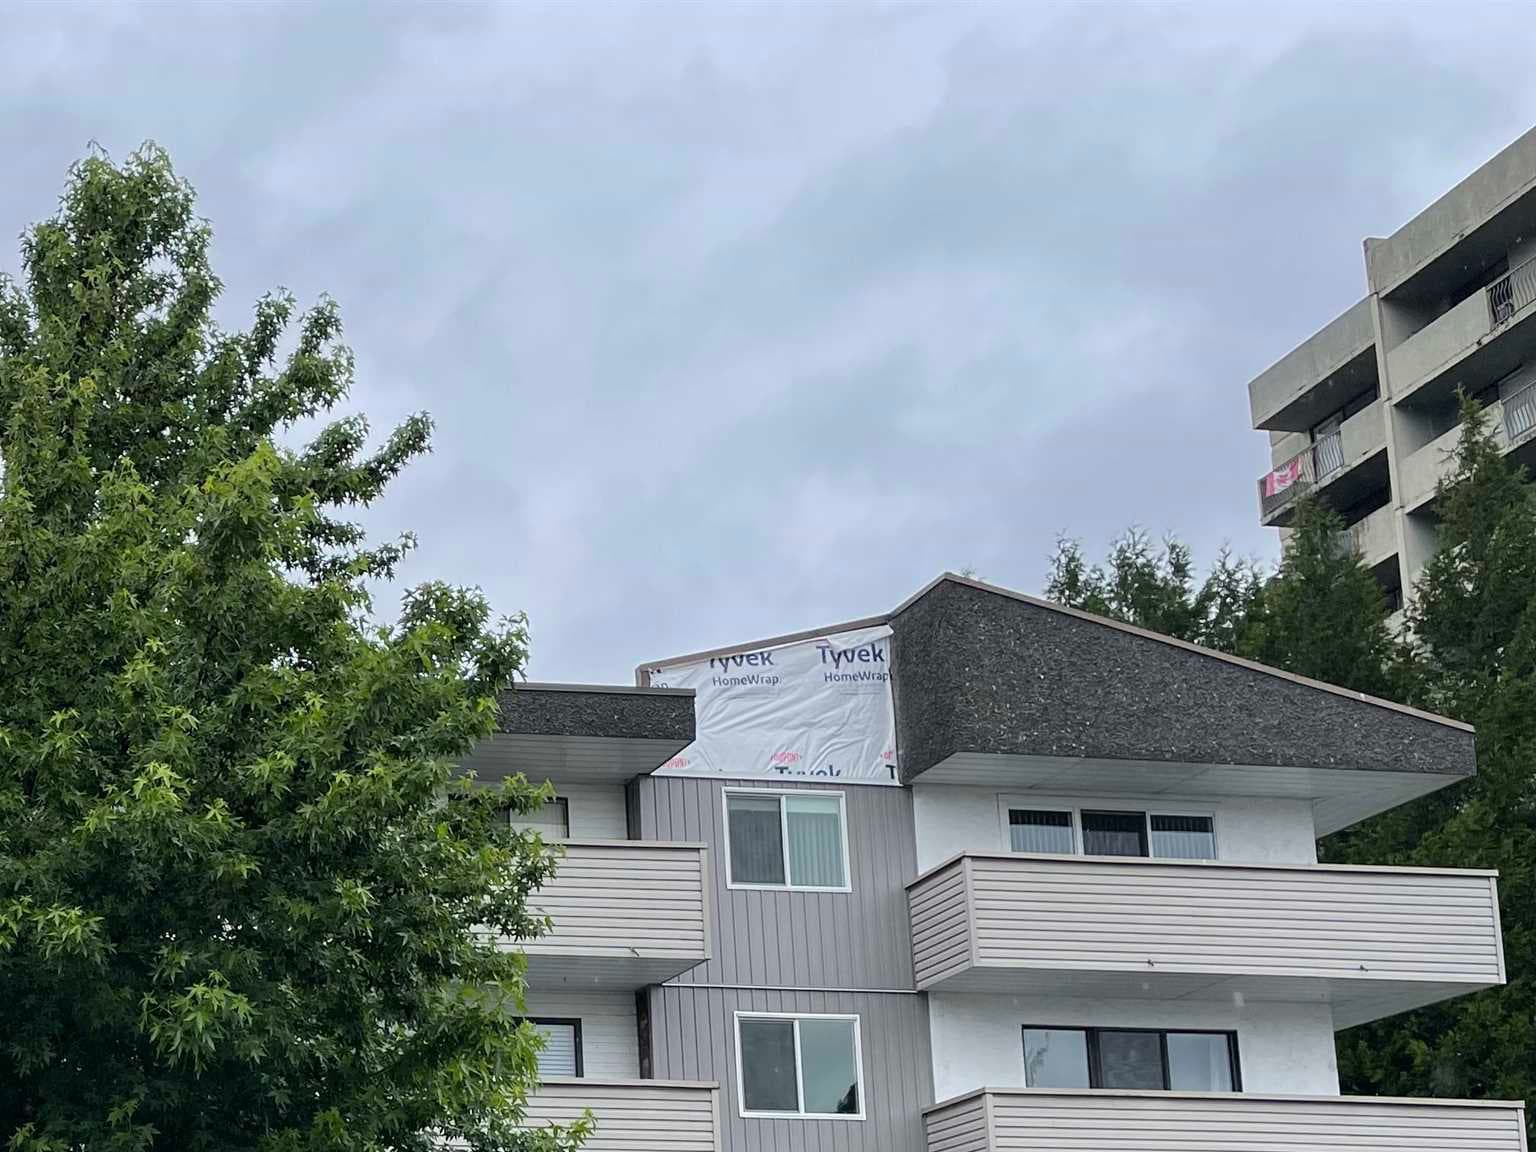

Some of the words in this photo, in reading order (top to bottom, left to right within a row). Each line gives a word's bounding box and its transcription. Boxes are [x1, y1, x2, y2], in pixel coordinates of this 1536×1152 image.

[816, 643, 885, 670] Tyvek
[712, 674, 779, 687] HomeWrap
[824, 671, 890, 683] HomeWrap
